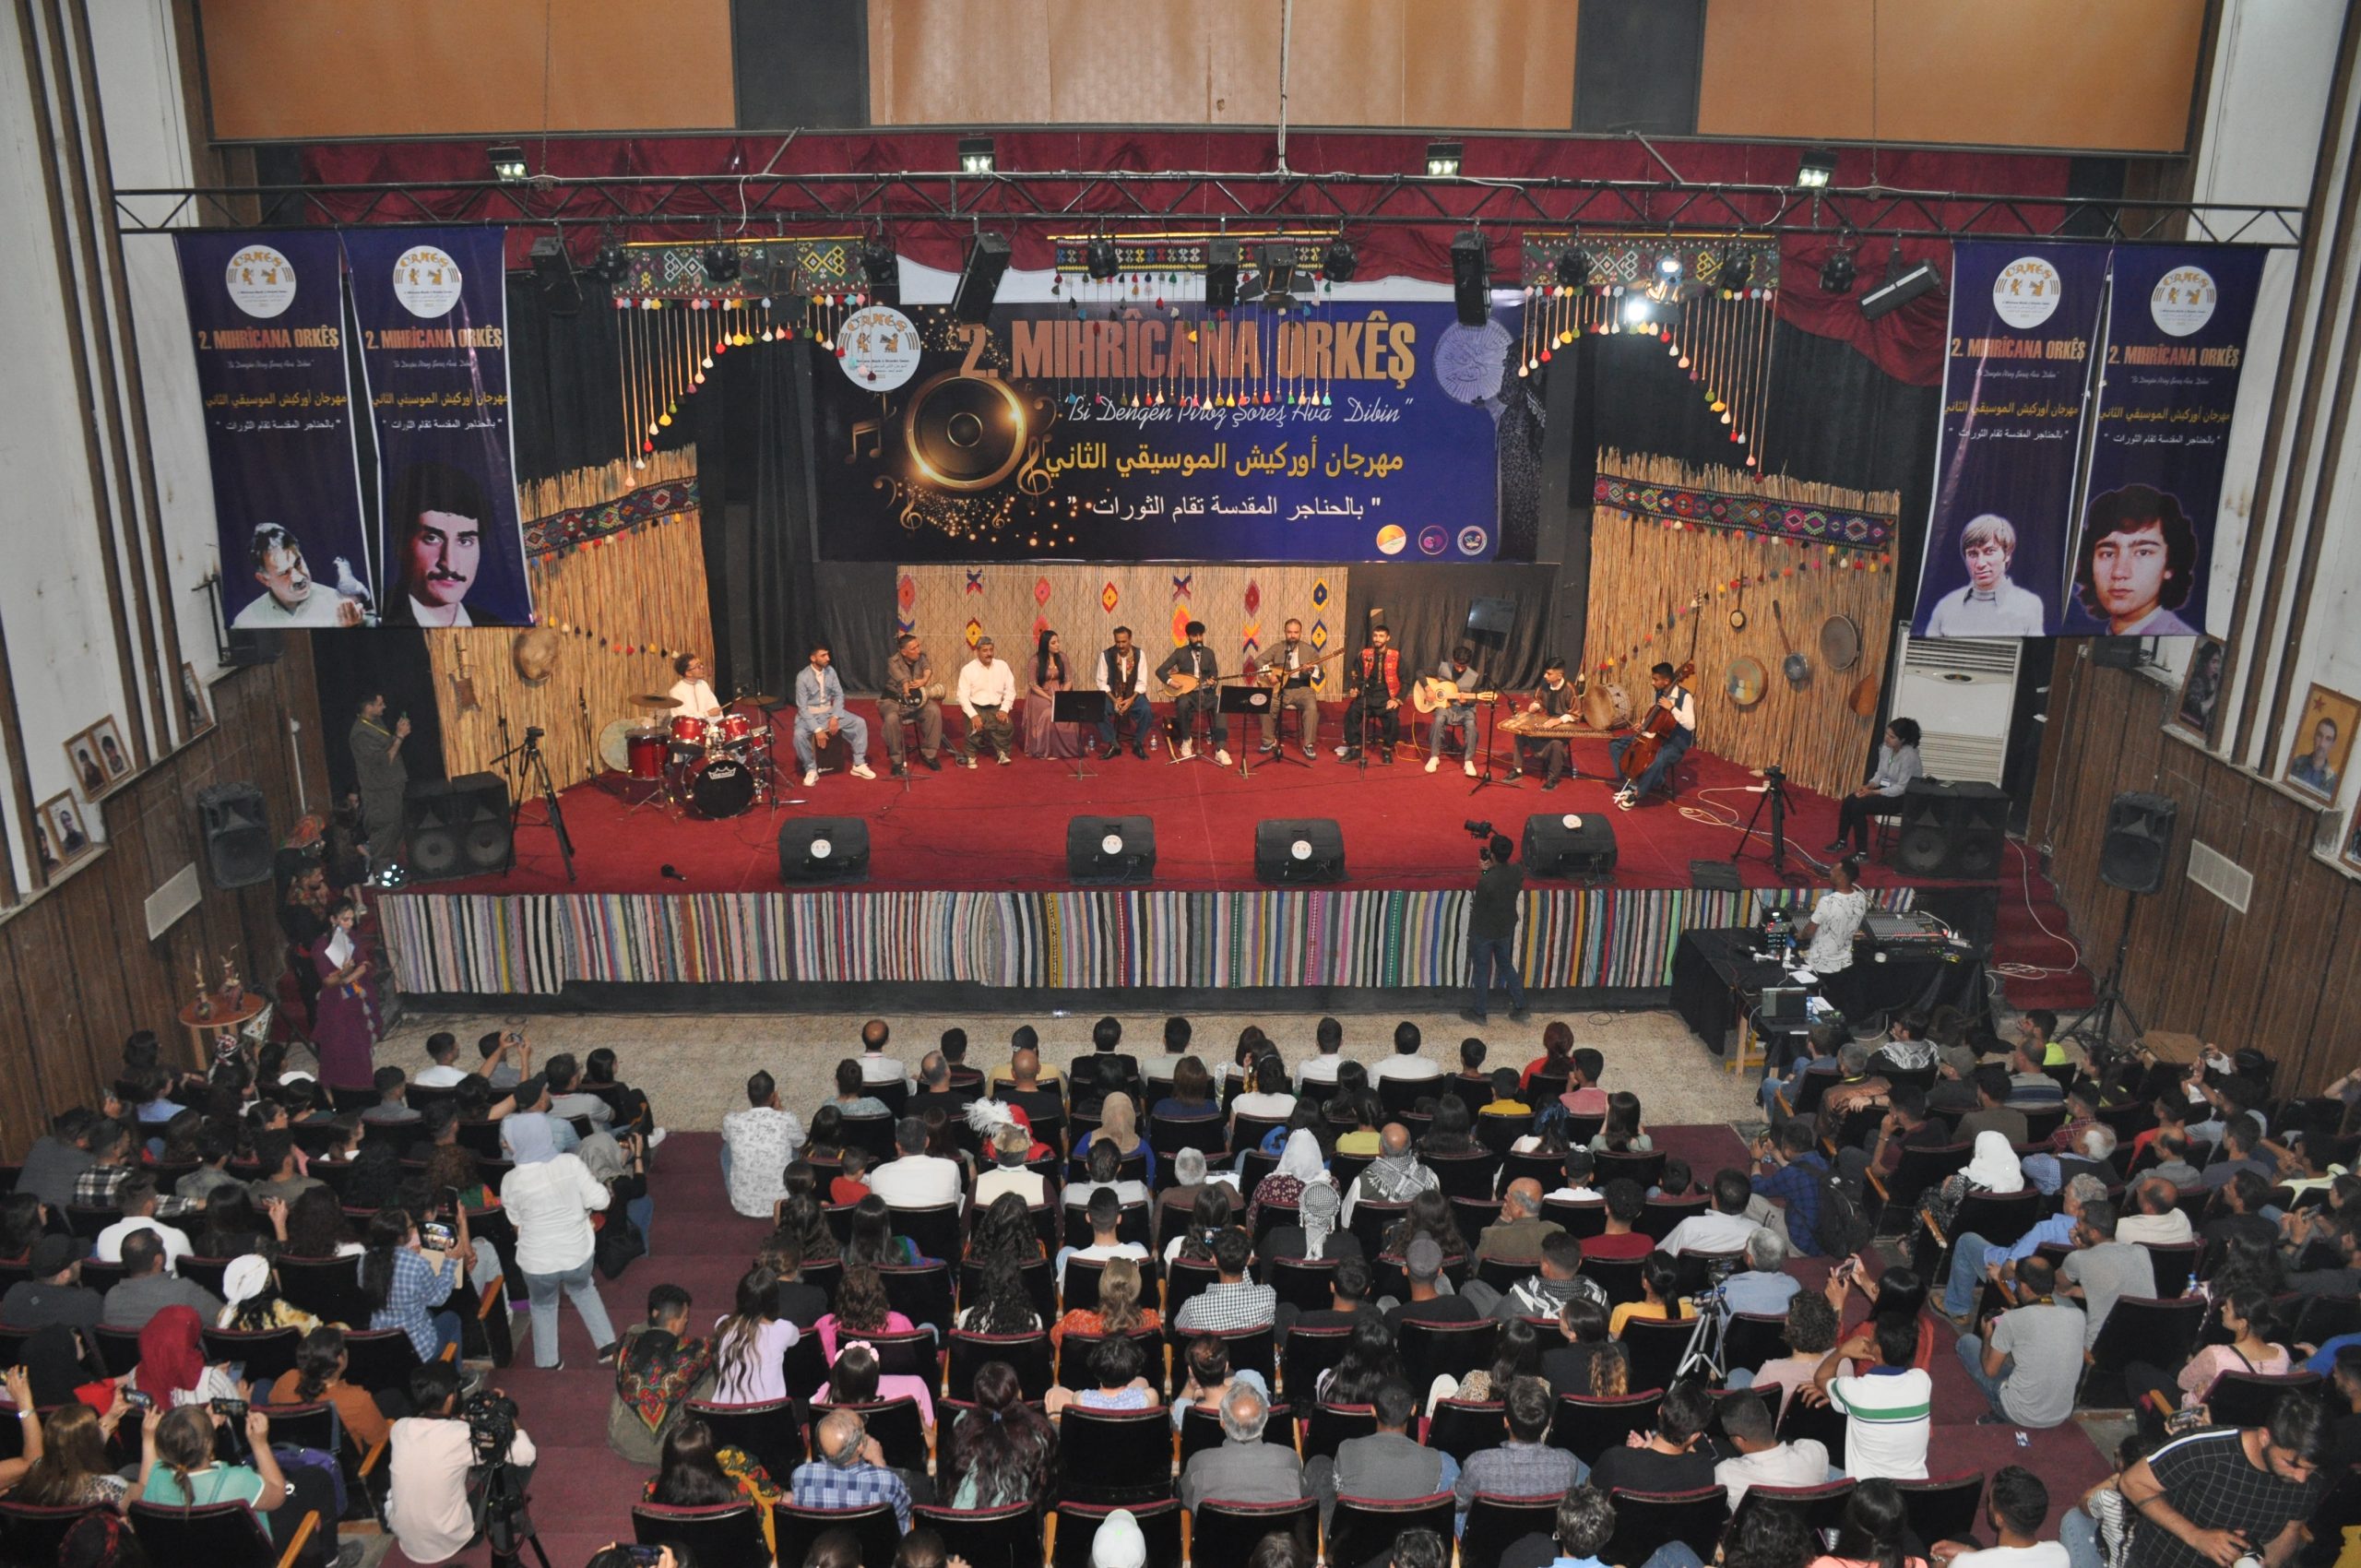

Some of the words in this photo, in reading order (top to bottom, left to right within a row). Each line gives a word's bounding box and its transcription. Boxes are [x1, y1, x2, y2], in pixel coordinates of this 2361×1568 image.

[197, 331, 211, 350] 2.
[213, 326, 291, 350] MIHRÎCANA
[293, 324, 340, 350] ORKÊŞ
[365, 331, 379, 349] 2.
[380, 326, 456, 349] MIHRÎCANA
[457, 324, 504, 350] ORKÊŞ
[958, 323, 999, 377] 2.
[1011, 308, 1263, 379] MIHRÎCANA
[1276, 309, 1417, 390] ORKÊŞ
[1951, 338, 1964, 358] 2.
[1967, 335, 2042, 359] MIHRÎCANA
[2046, 337, 2087, 362] ORKÊŞ
[2107, 345, 2120, 364] 2.
[2123, 343, 2197, 366] MIHRÎCANA
[2200, 344, 2240, 369] ORKÊŞ
[1096, 395, 1174, 430] Dengên
[1178, 396, 1227, 431] Piroz
[1231, 396, 1287, 428] Şoreş
[1045, 442, 1107, 478] الثاني
[1115, 442, 1227, 478] الموسيقي
[1235, 434, 1319, 478] أوركيش
[1325, 443, 1404, 478] مهرجان
[1092, 494, 1165, 521] الثورات
[1171, 495, 1204, 524] تقام
[1210, 494, 1277, 516] المقدسة
[1286, 495, 1364, 521] بالحناجر
